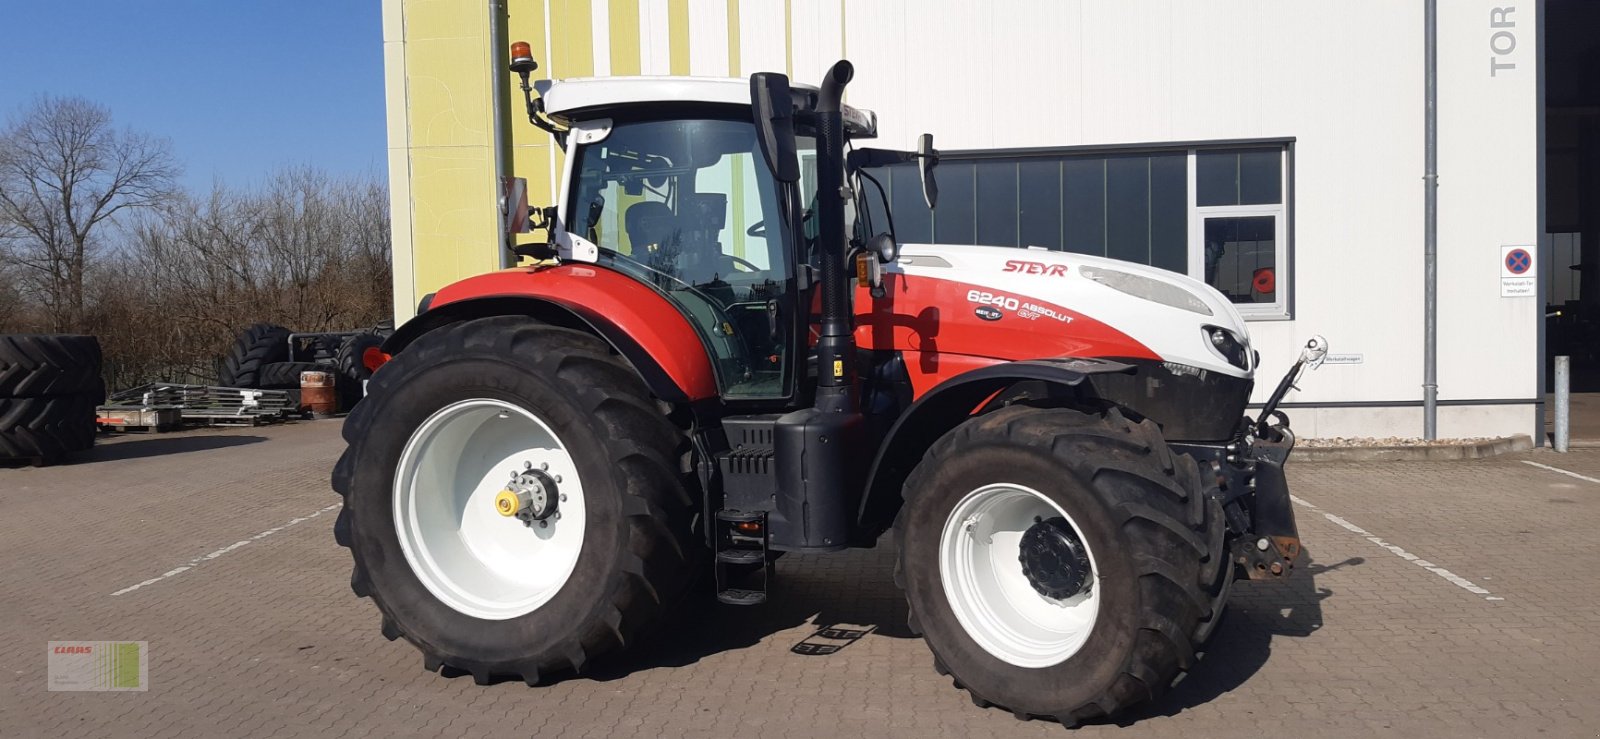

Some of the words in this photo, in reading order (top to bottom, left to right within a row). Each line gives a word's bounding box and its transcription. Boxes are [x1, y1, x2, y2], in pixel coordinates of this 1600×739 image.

[1490, 6, 1516, 77] TOR
[1002, 259, 1068, 277] STEYR
[967, 289, 1020, 311] 6240
[1022, 302, 1073, 323] ABSOLUT
